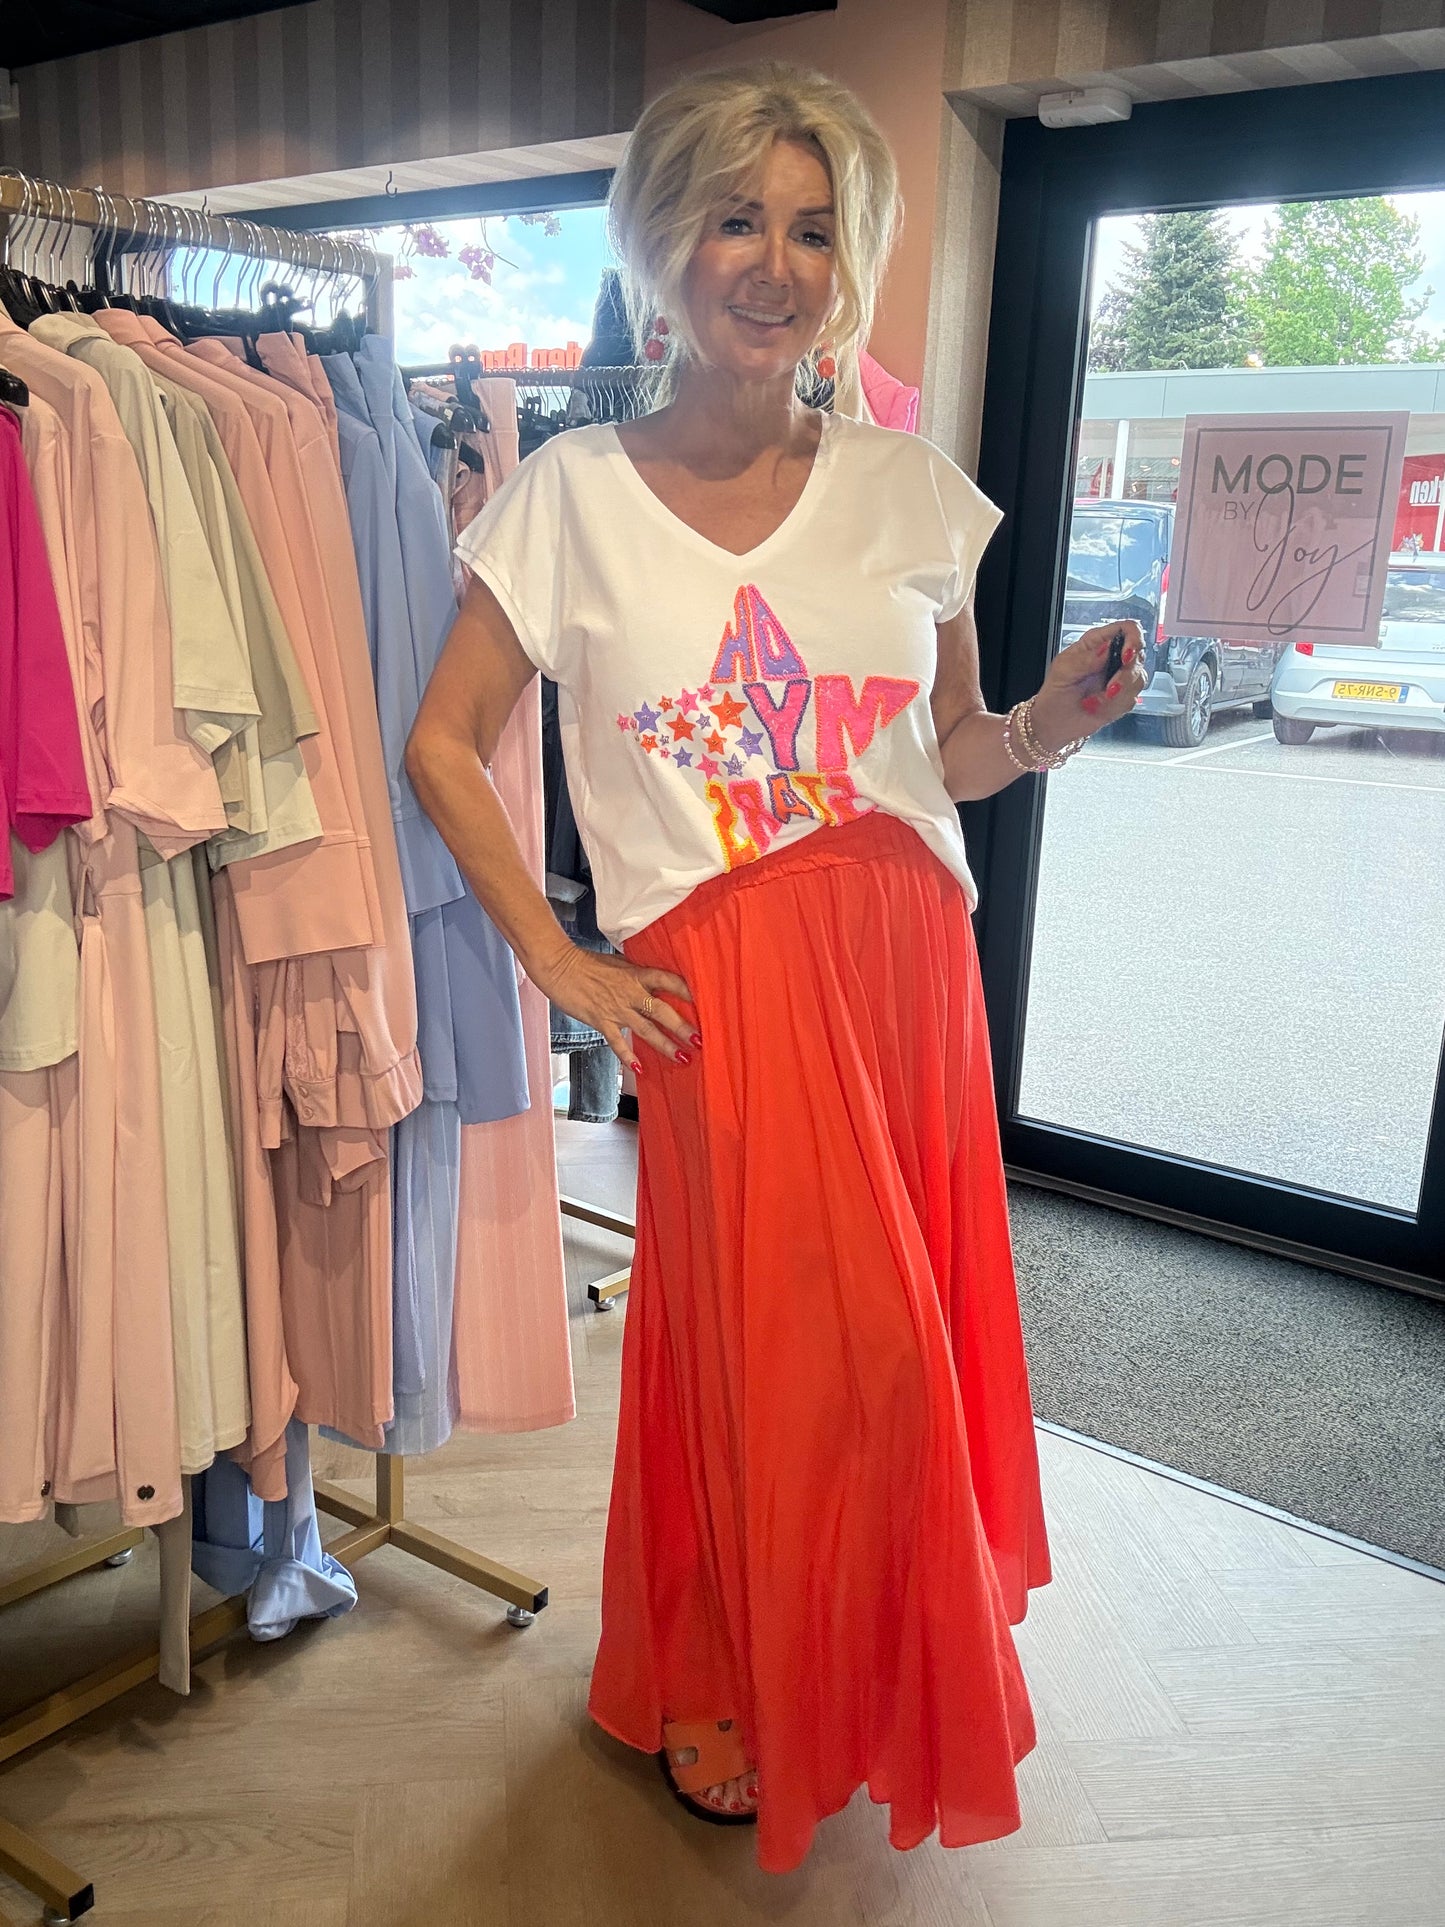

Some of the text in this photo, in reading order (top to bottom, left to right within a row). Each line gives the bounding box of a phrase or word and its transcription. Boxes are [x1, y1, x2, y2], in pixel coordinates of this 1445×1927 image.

[1211, 453, 1367, 495] MODE
[1223, 482, 1375, 635] BY Joy
